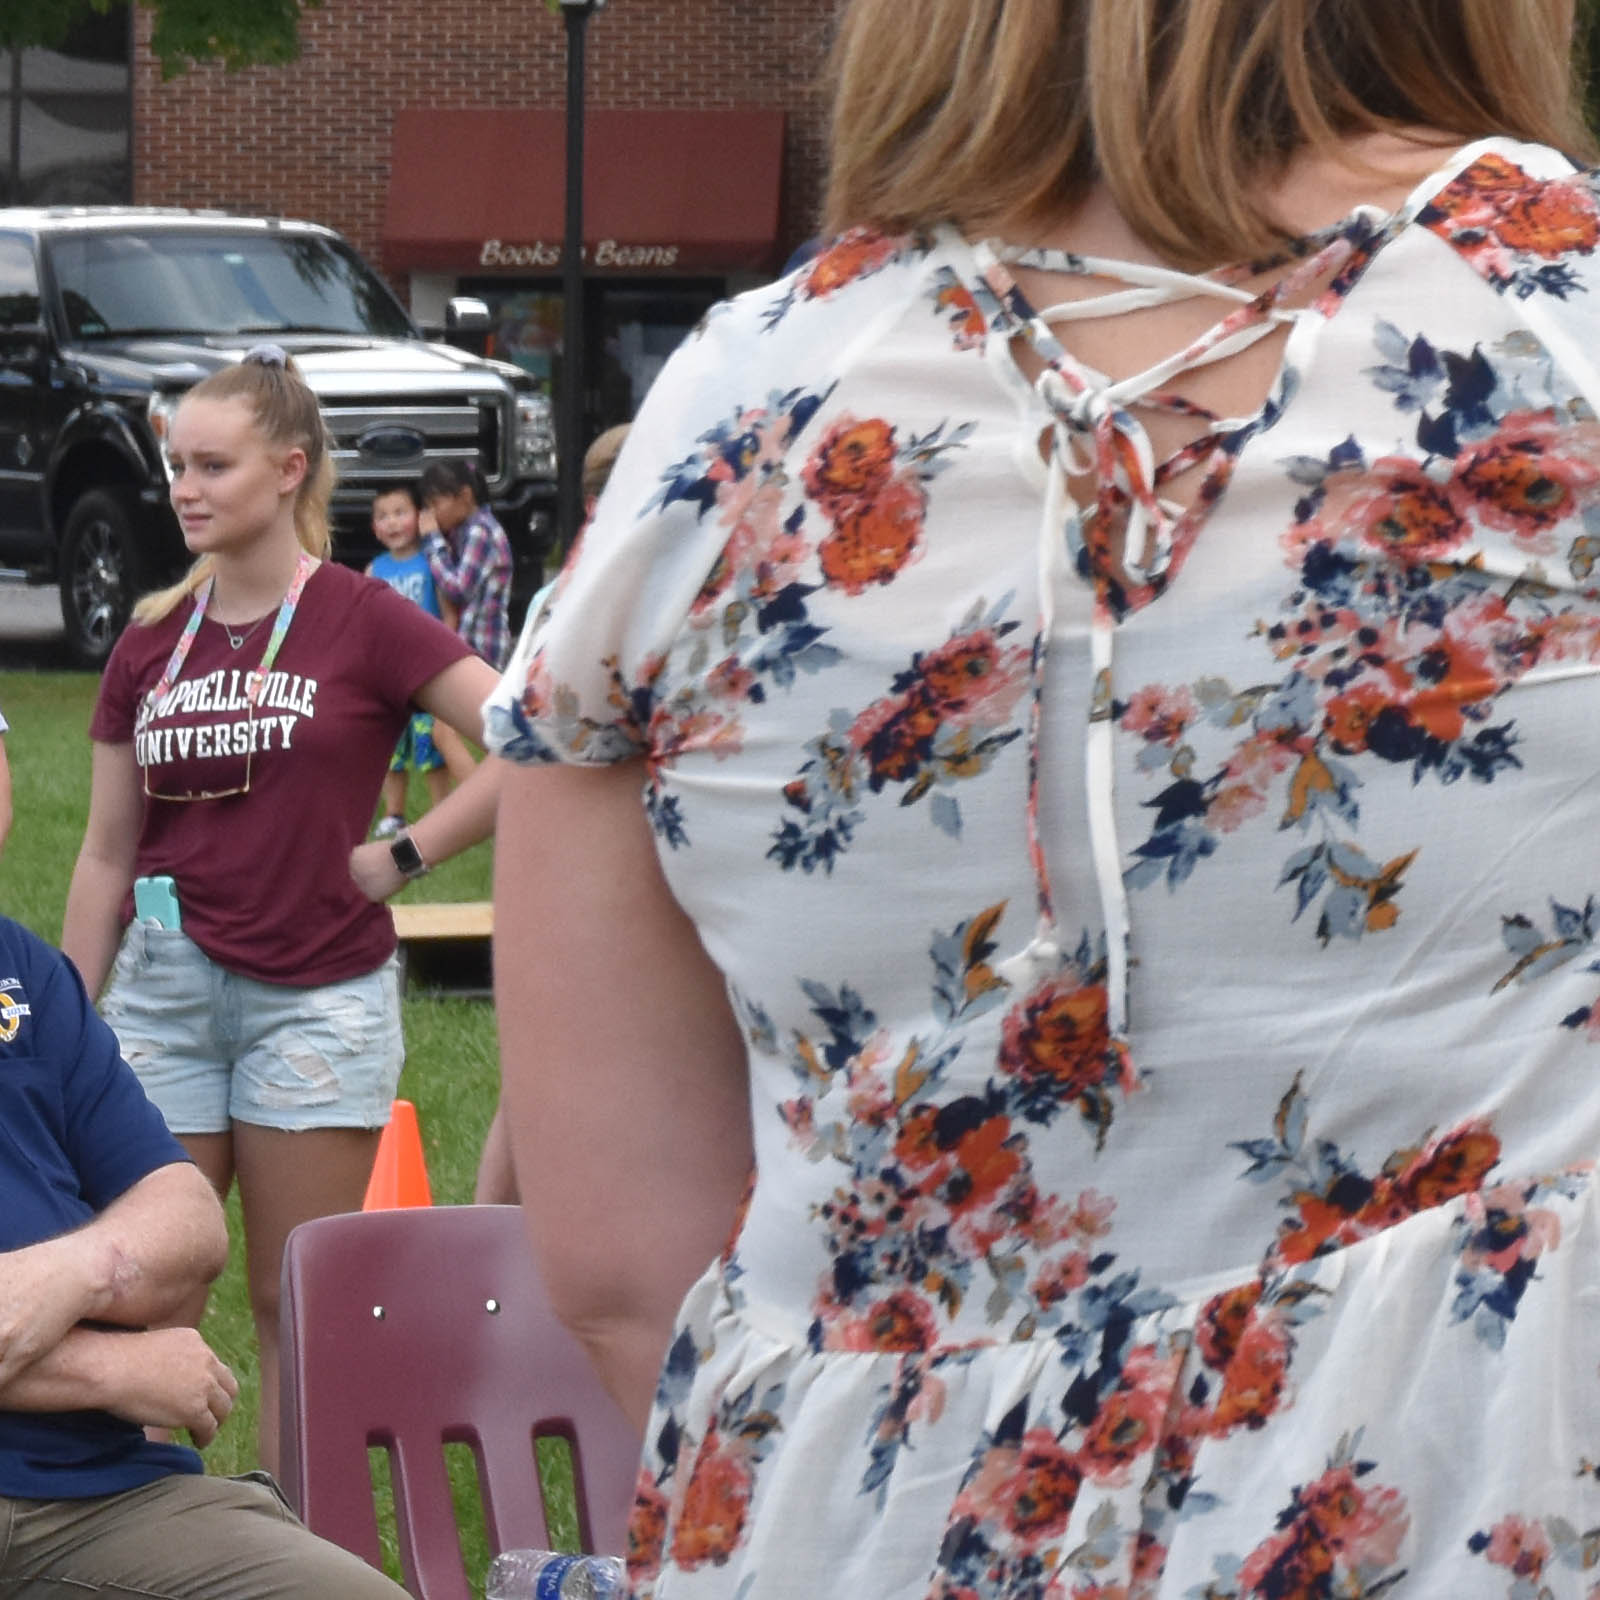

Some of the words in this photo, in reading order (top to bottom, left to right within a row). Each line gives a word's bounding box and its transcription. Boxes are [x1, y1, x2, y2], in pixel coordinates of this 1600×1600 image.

[479, 239, 561, 266] Books
[594, 239, 679, 266] Beans
[135, 715, 298, 767] UNIVERSITY
